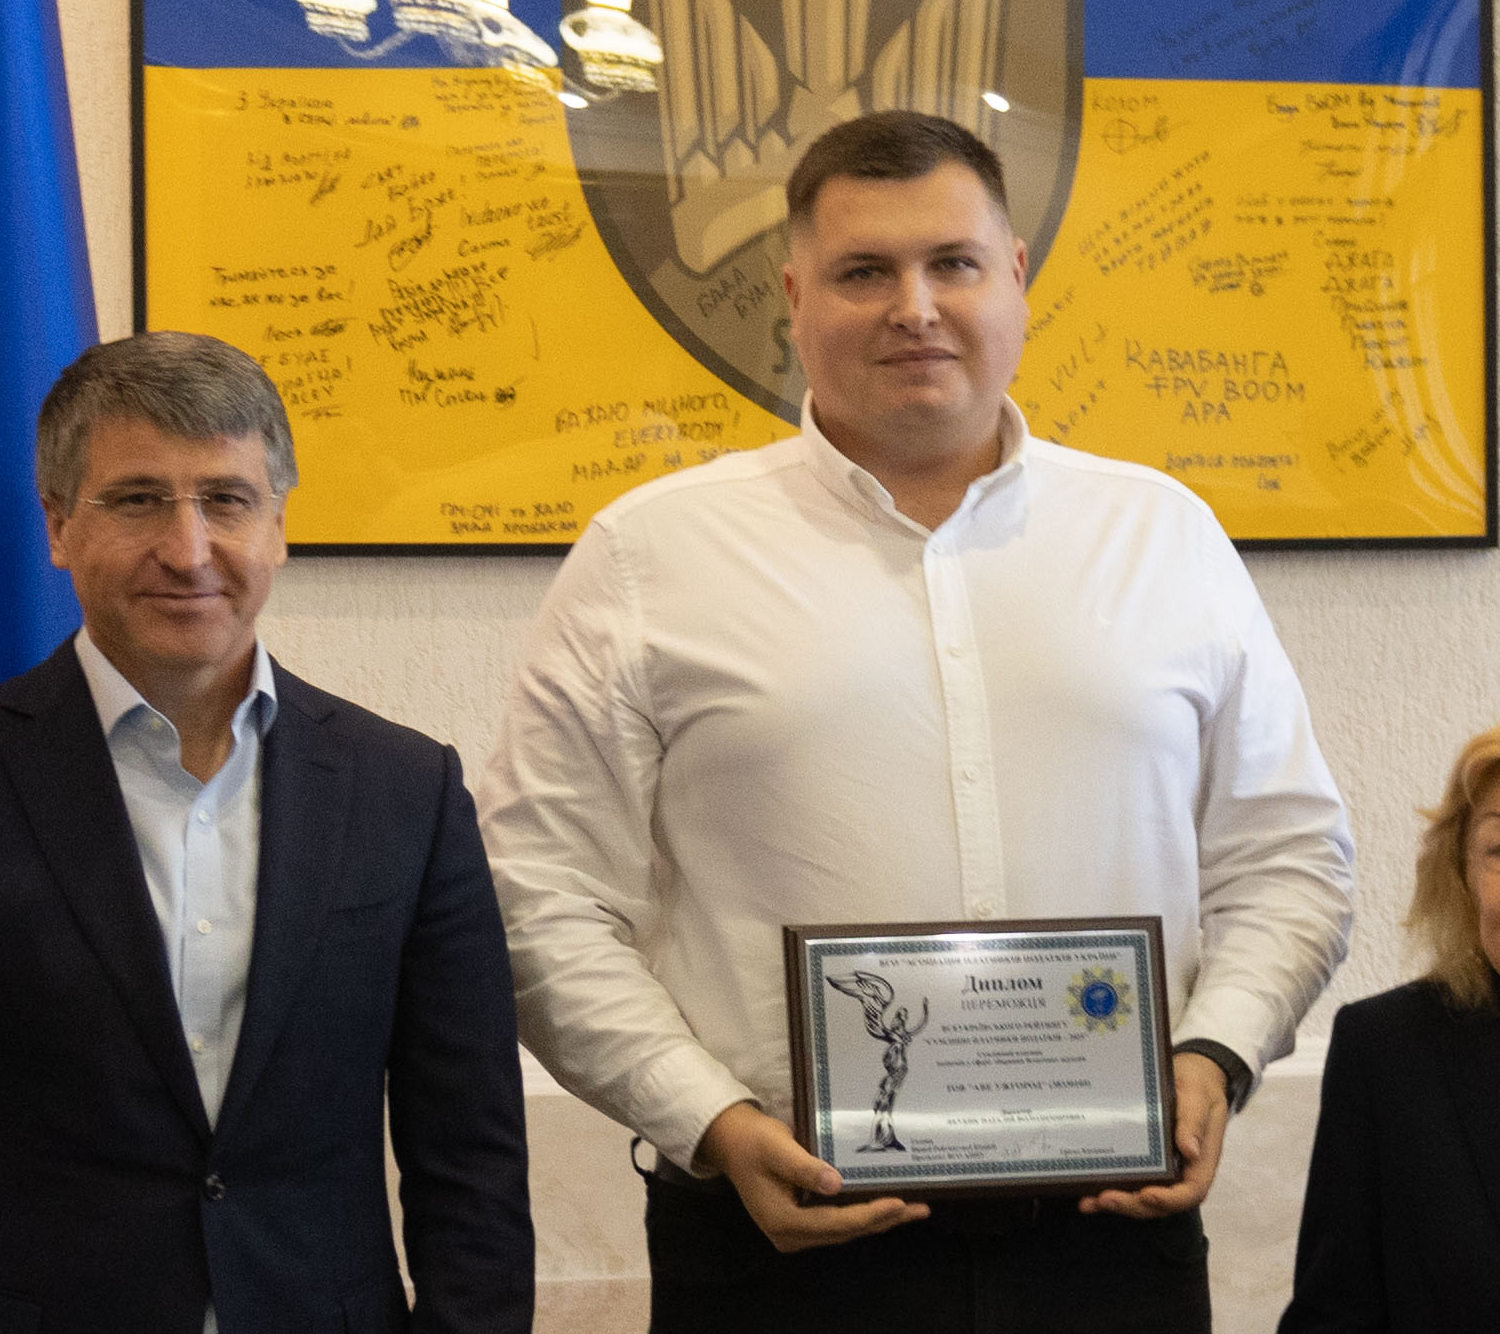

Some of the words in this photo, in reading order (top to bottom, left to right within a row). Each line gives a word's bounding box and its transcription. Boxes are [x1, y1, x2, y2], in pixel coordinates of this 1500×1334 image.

[1125, 338, 1291, 376] КАВАБАНГА
[1145, 375, 1208, 400] FPV
[1223, 378, 1306, 403] BOOM
[960, 973, 1044, 996] Диплом
